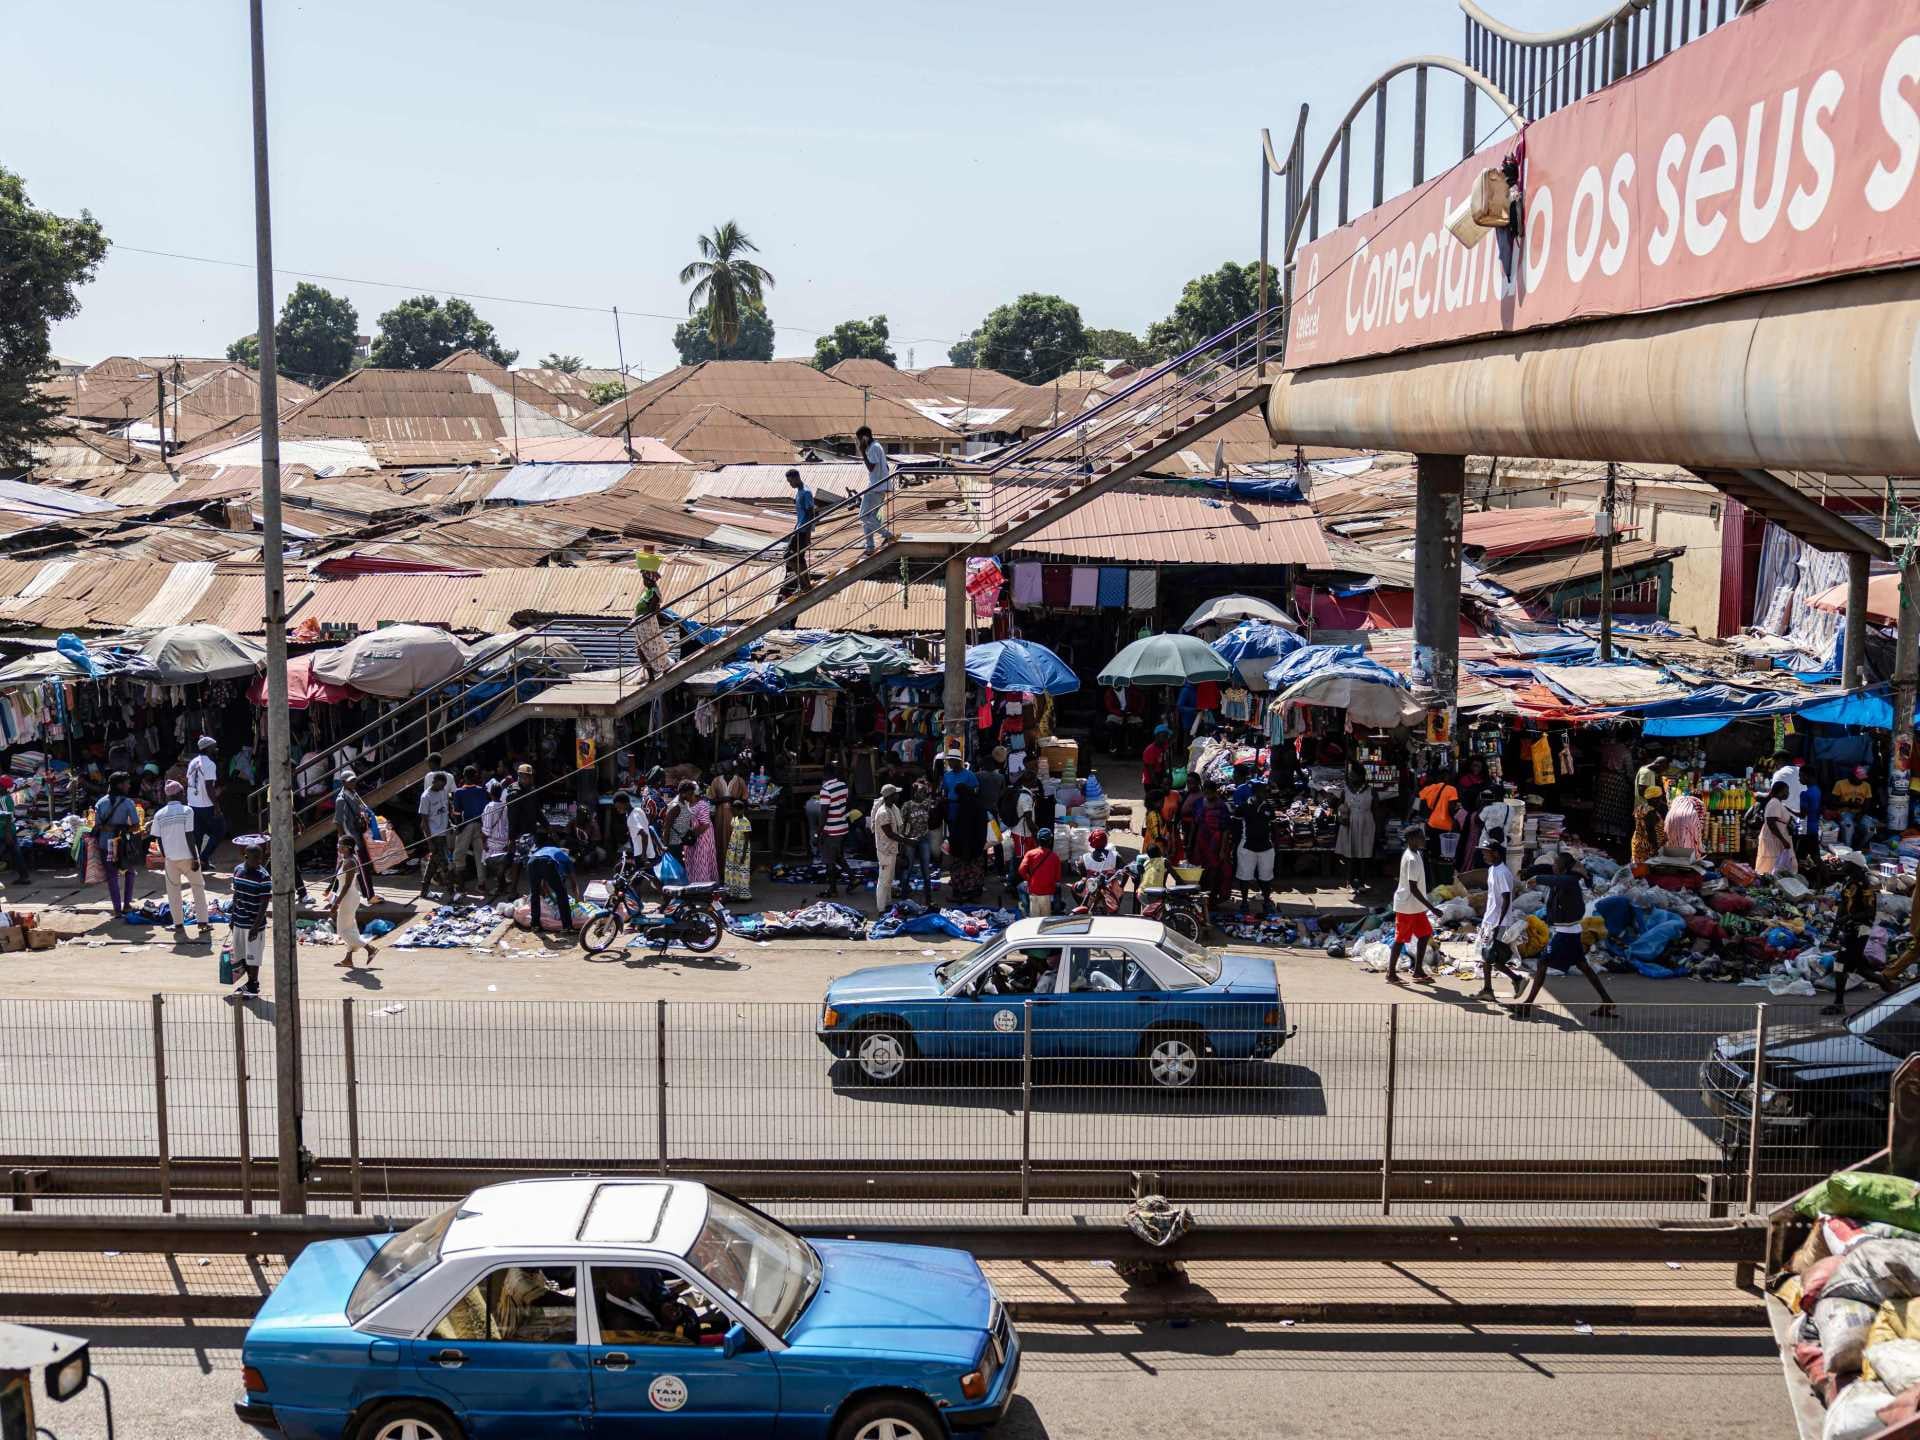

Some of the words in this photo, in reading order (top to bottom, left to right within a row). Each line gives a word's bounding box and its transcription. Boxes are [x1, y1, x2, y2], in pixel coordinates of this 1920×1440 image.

[1566, 152, 1636, 284] os
[1648, 69, 1846, 266] seus
[656, 1388, 682, 1396] TAXI
